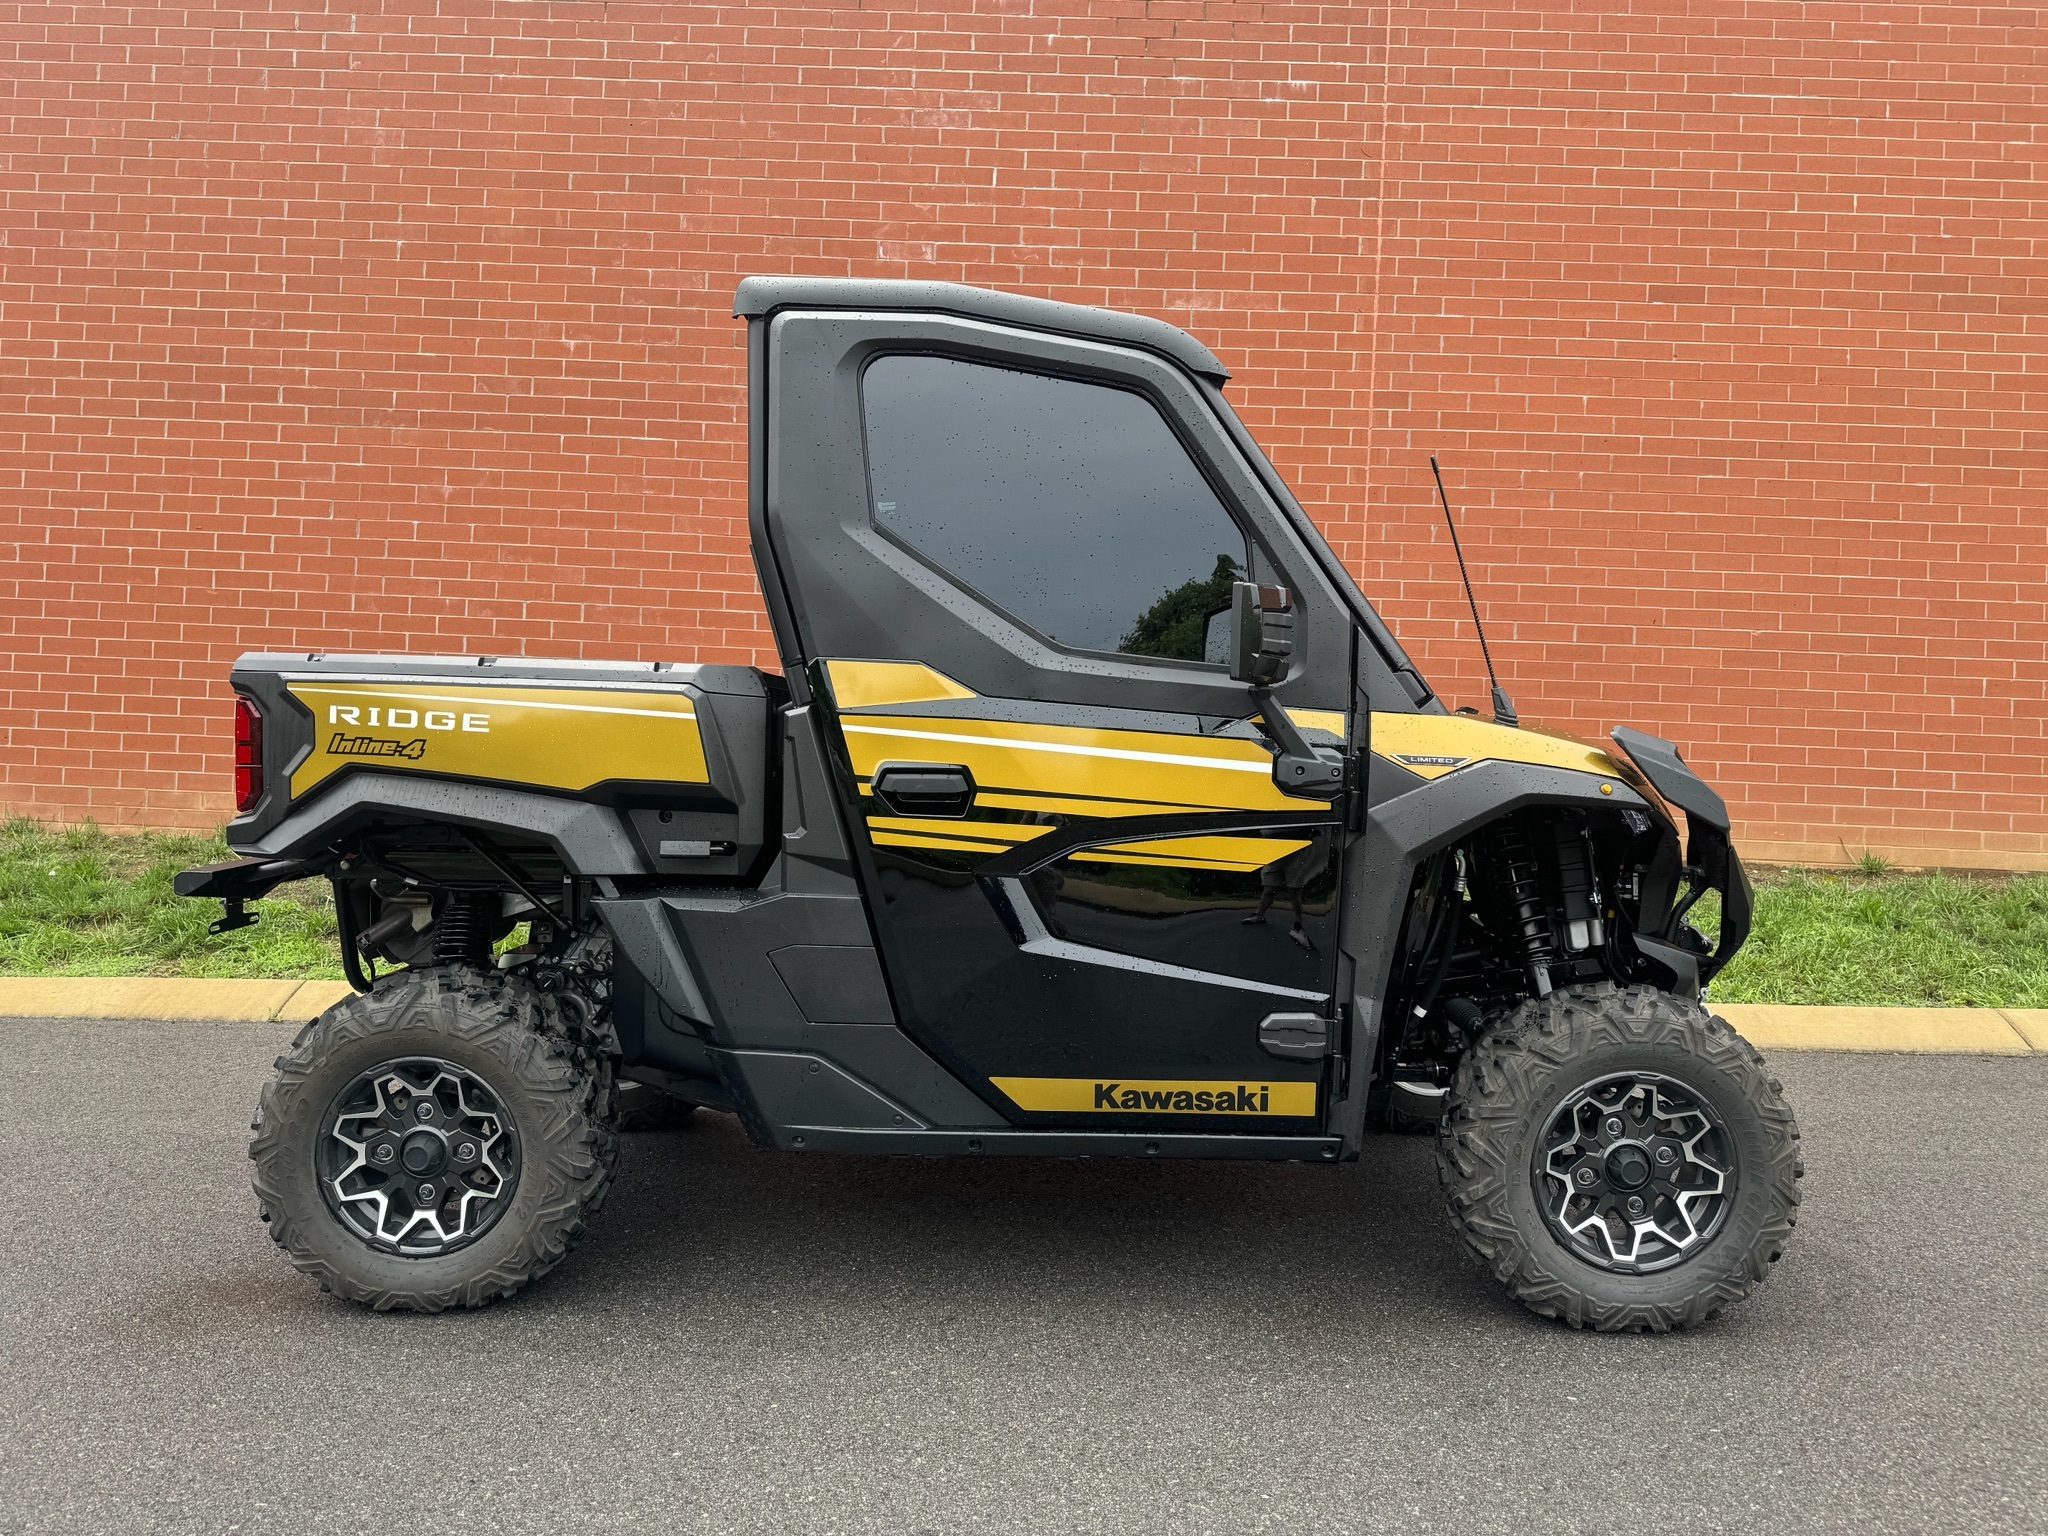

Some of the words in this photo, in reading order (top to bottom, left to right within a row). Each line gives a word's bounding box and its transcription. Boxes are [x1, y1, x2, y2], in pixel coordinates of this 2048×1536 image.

[329, 705, 491, 733] RIDGE
[326, 733, 427, 760] Inline-4
[1093, 1083, 1270, 1113] Kawasaki
[1511, 1082, 1556, 1163] DURO
[514, 1194, 535, 1223] V2
[1707, 1243, 1740, 1268] V2
